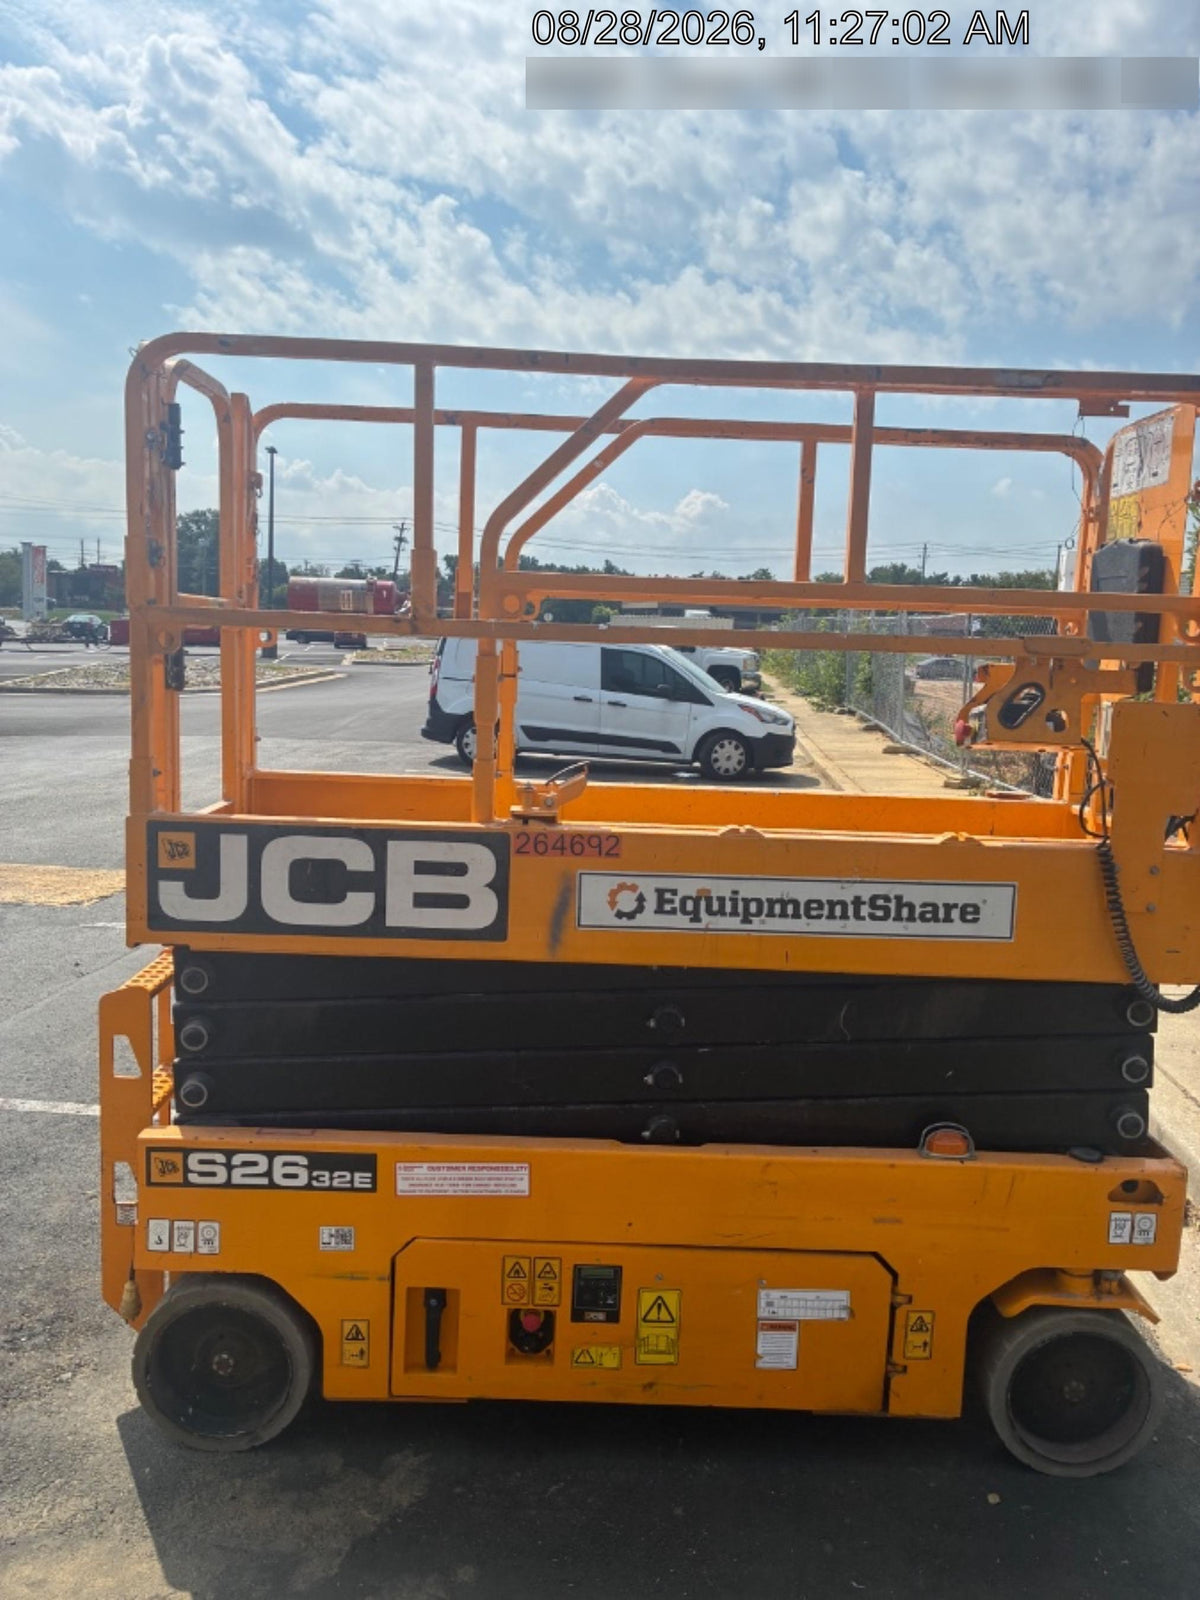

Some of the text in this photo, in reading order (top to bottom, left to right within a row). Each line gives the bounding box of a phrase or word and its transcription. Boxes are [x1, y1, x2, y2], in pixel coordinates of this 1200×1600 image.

[515, 832, 622, 857] 264692
[158, 833, 499, 930] JCB
[653, 887, 981, 925] EquipmentShare
[187, 1152, 373, 1189] S26 32E
[467, 1165, 528, 1173] RESPONSIBILITY
